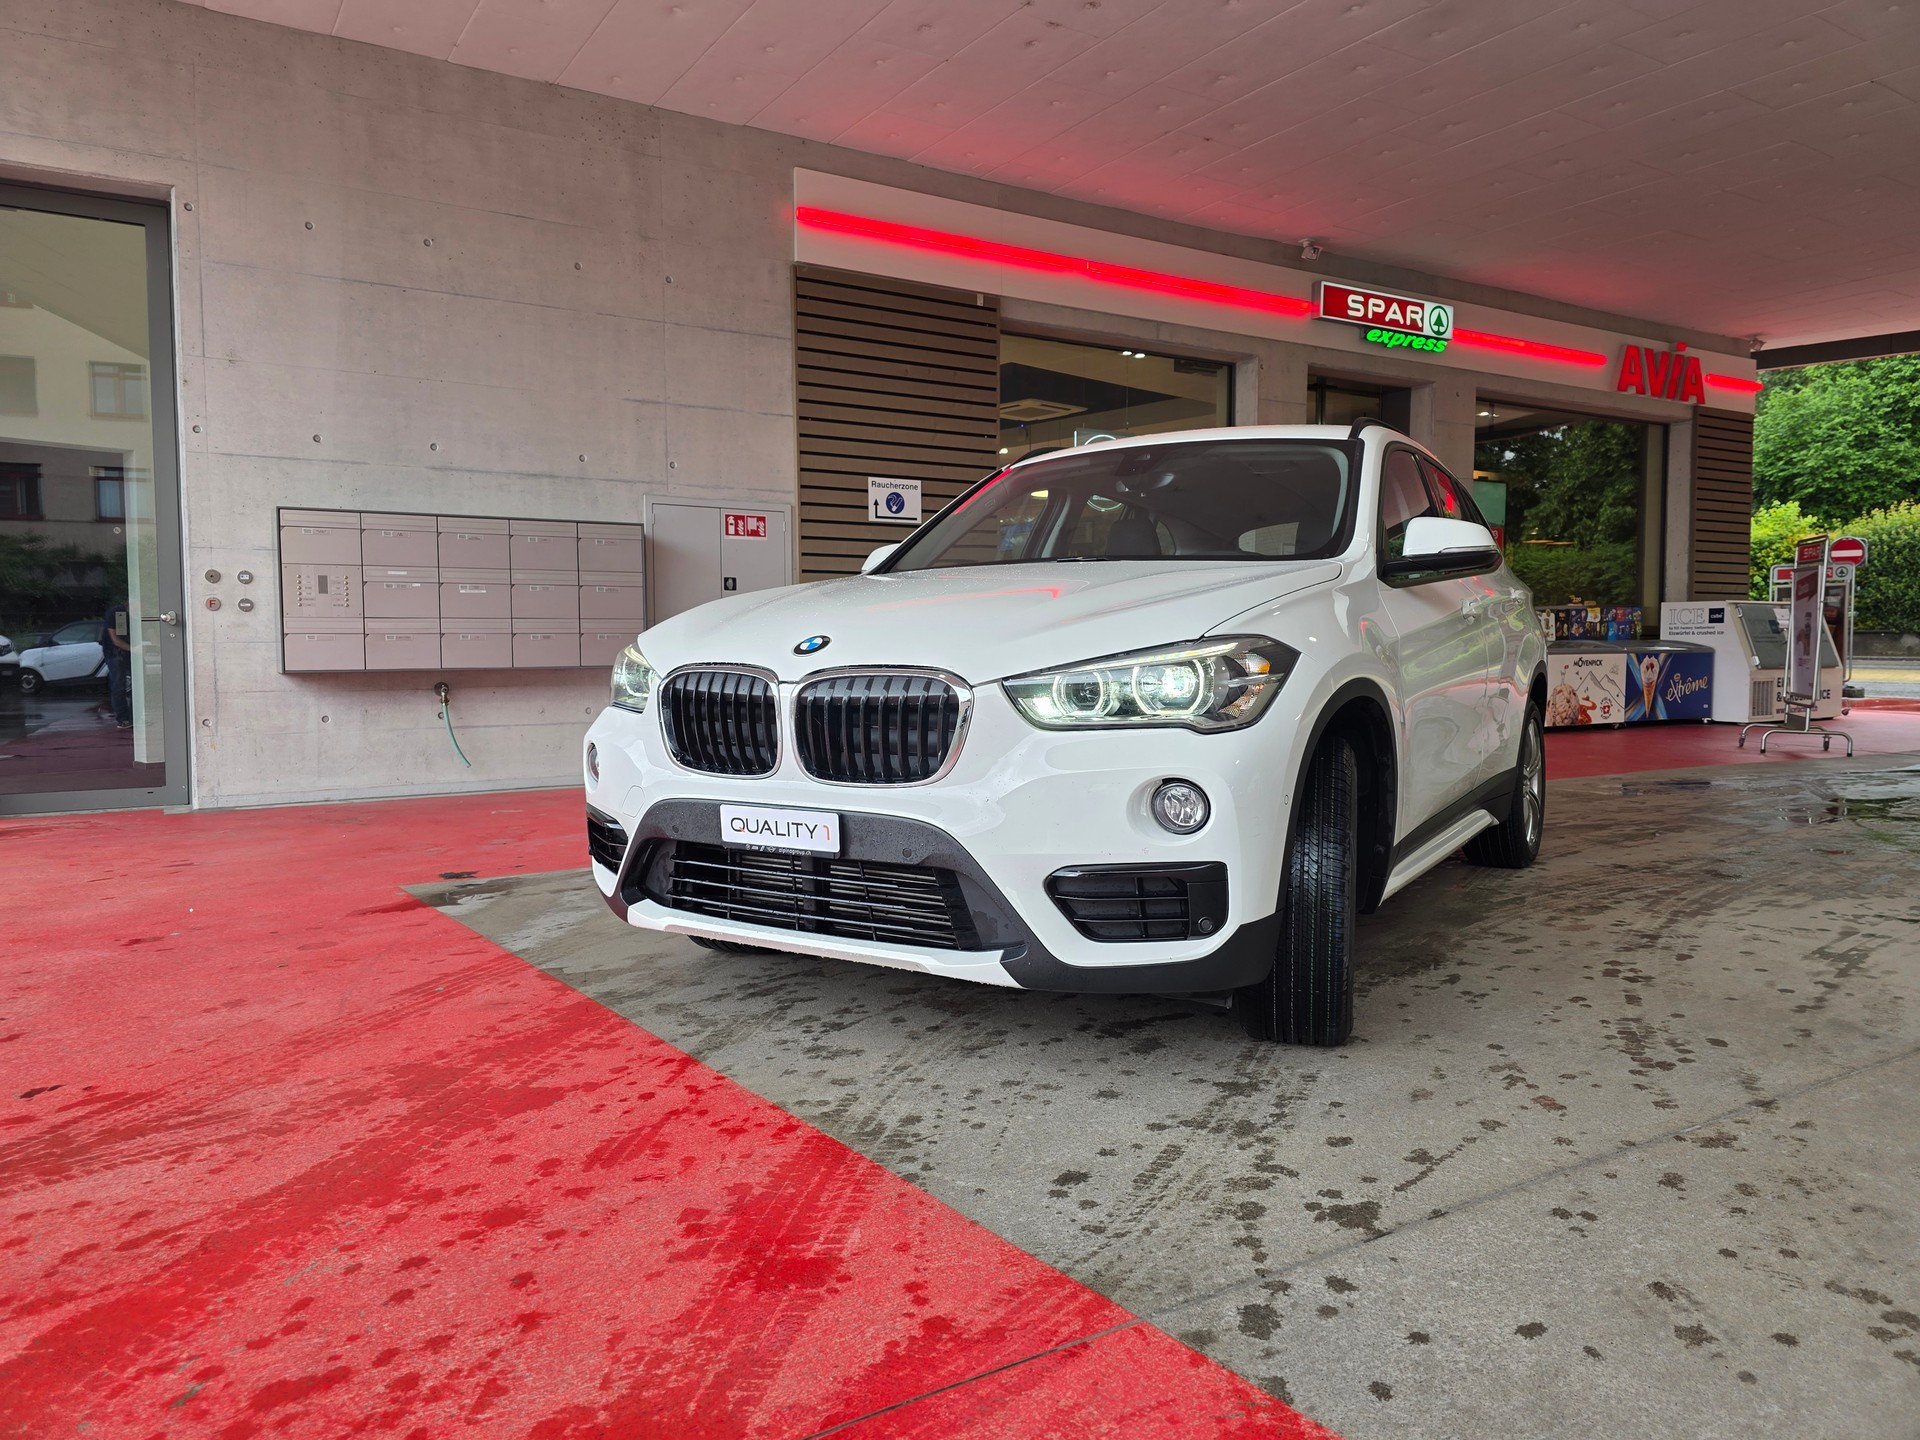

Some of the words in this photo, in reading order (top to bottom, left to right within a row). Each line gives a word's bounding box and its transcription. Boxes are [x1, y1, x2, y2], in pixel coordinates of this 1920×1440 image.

[1346, 294, 1424, 329] SPAR
[1366, 328, 1448, 353] express
[871, 480, 919, 491] Raucherzone
[209, 599, 217, 608] F
[1669, 608, 1705, 625] ICE
[730, 817, 818, 839] QUALITY
[823, 824, 831, 841] 1
